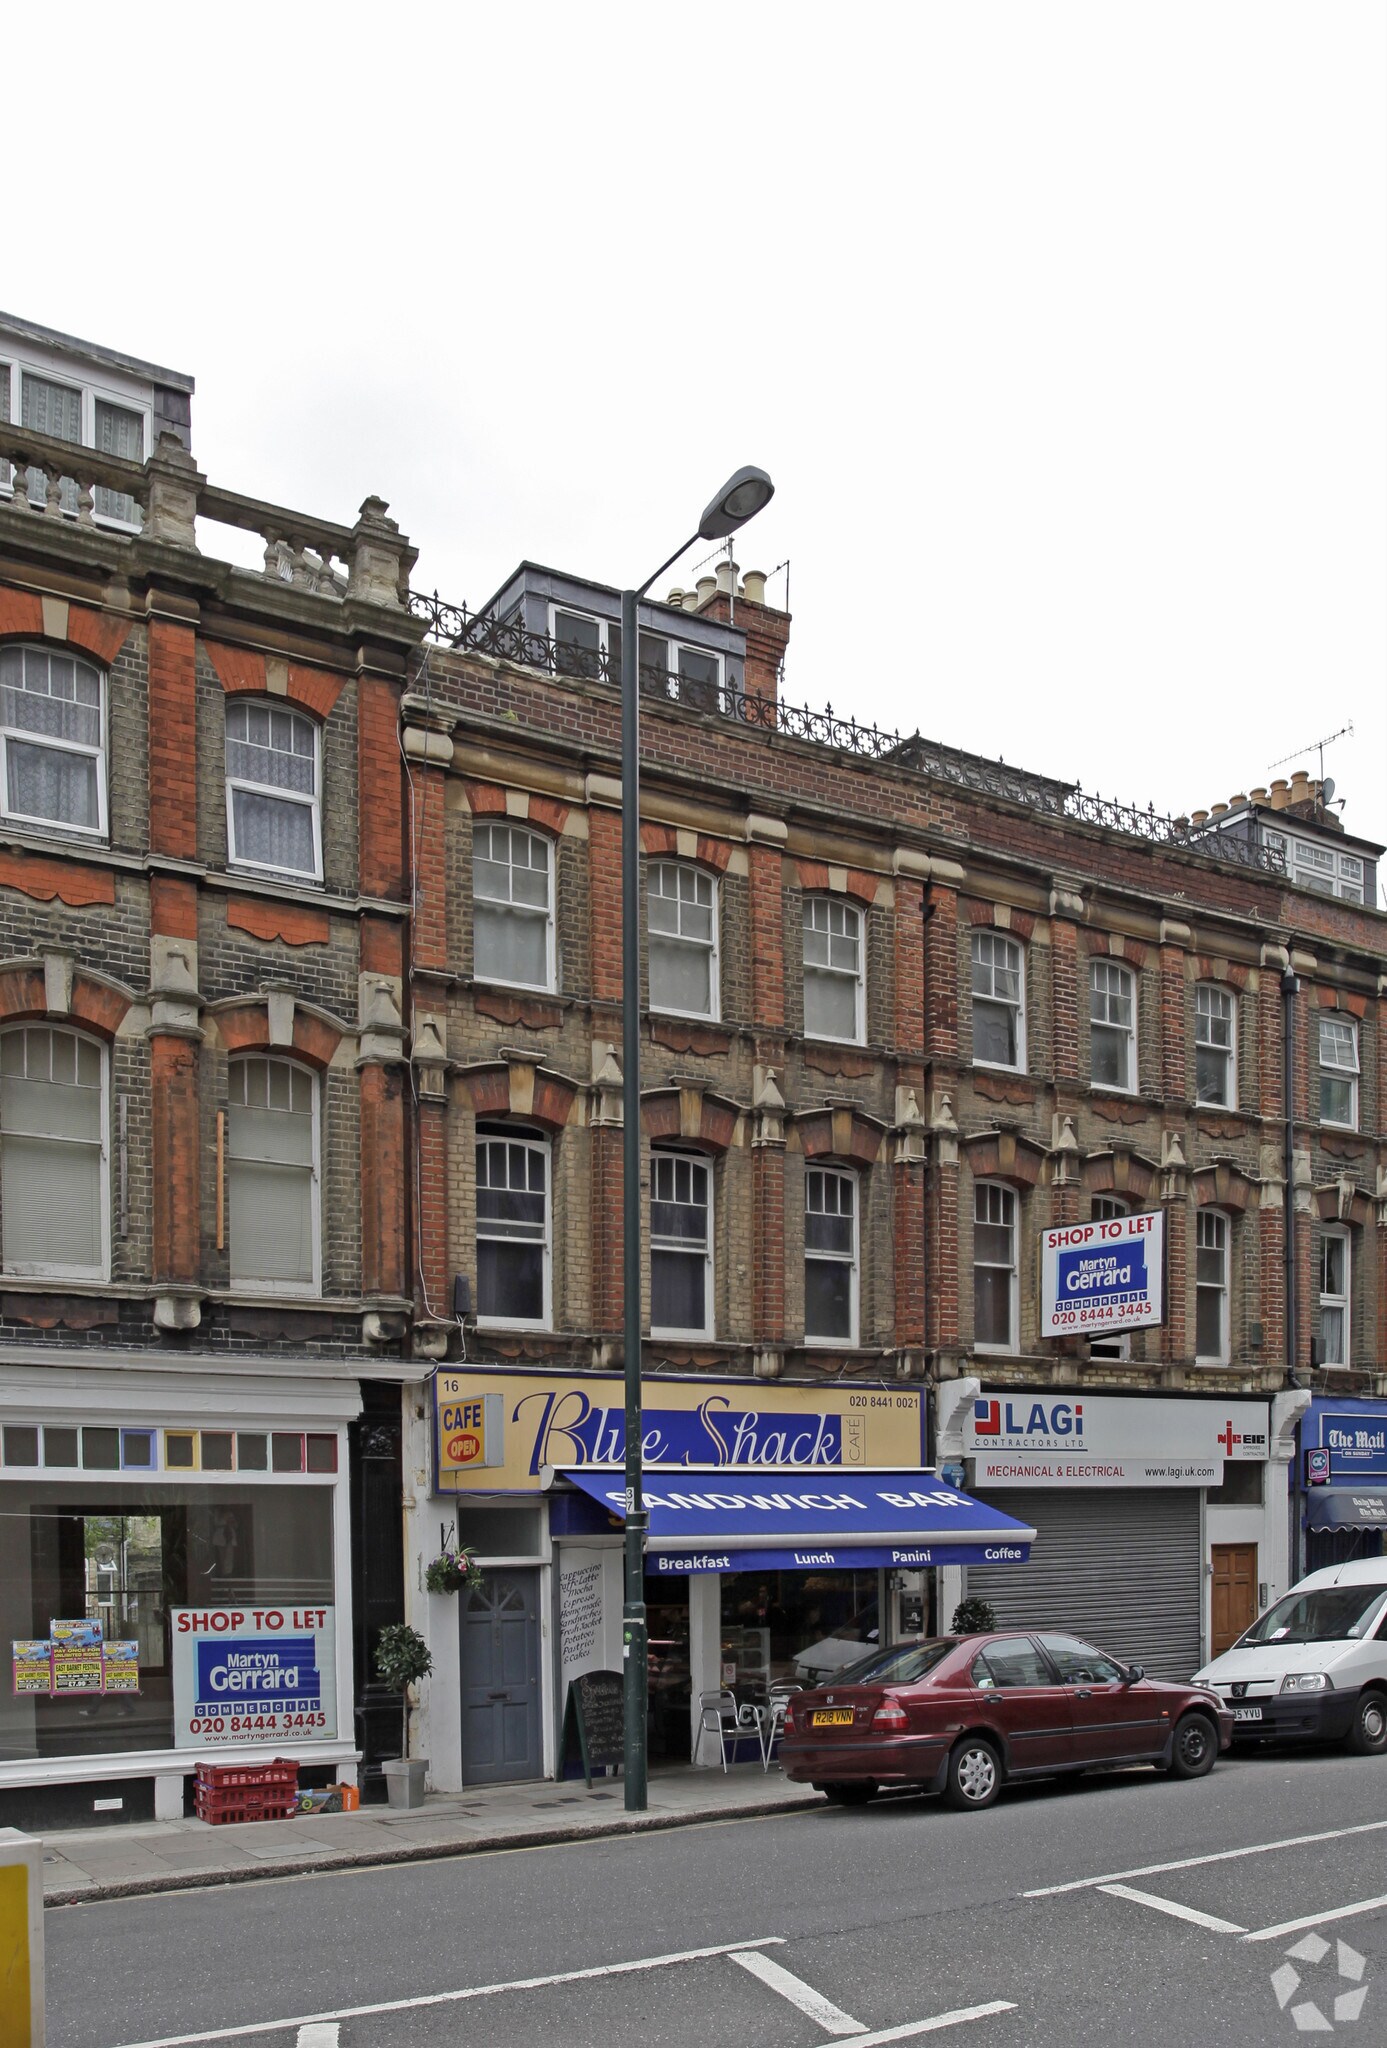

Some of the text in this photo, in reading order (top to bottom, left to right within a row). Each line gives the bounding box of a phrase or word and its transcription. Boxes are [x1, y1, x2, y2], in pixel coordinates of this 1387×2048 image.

[1048, 1216, 1154, 1248] SHOP TO LET
[1079, 1256, 1117, 1271] Martyn
[1066, 1265, 1131, 1291] Gerrard
[1056, 1293, 1146, 1311] COMMERCIAL
[1051, 1302, 1152, 1325] 020 8444 3445
[1061, 1315, 1142, 1331] www.martyngerrard.co.uk
[444, 1380, 459, 1392] 16
[849, 1395, 919, 1409] 020 8441 0021
[444, 1404, 481, 1431] CAFE
[512, 1391, 842, 1476] Blue Shack
[847, 1418, 861, 1462] CAFÉ
[1329, 1429, 1386, 1449] The Mail
[451, 1440, 476, 1457] OPEN
[974, 1438, 1084, 1448] CONTRACTORS LTD
[986, 1465, 1125, 1478] MECHANICAL & ELECTRICAL
[1144, 1465, 1215, 1480] www.lagi.uk.com
[605, 1491, 974, 1511] SANDWICH BAR
[794, 1551, 835, 1564] Lunch
[892, 1550, 931, 1563] Panini
[985, 1547, 1022, 1560] Coffee
[658, 1555, 731, 1571] Breakfast
[177, 1610, 327, 1633] SHOP TO LET
[227, 1653, 279, 1669] Martyn
[209, 1665, 299, 1691] Gerrard
[195, 1701, 319, 1716] COMMERCIAL
[815, 1710, 853, 1723] R218 VNN
[1244, 1708, 1260, 1718] YVU
[189, 1712, 326, 1734] 020 8444 3445
[204, 1728, 312, 1742] www.martyngerrard.co.uk
